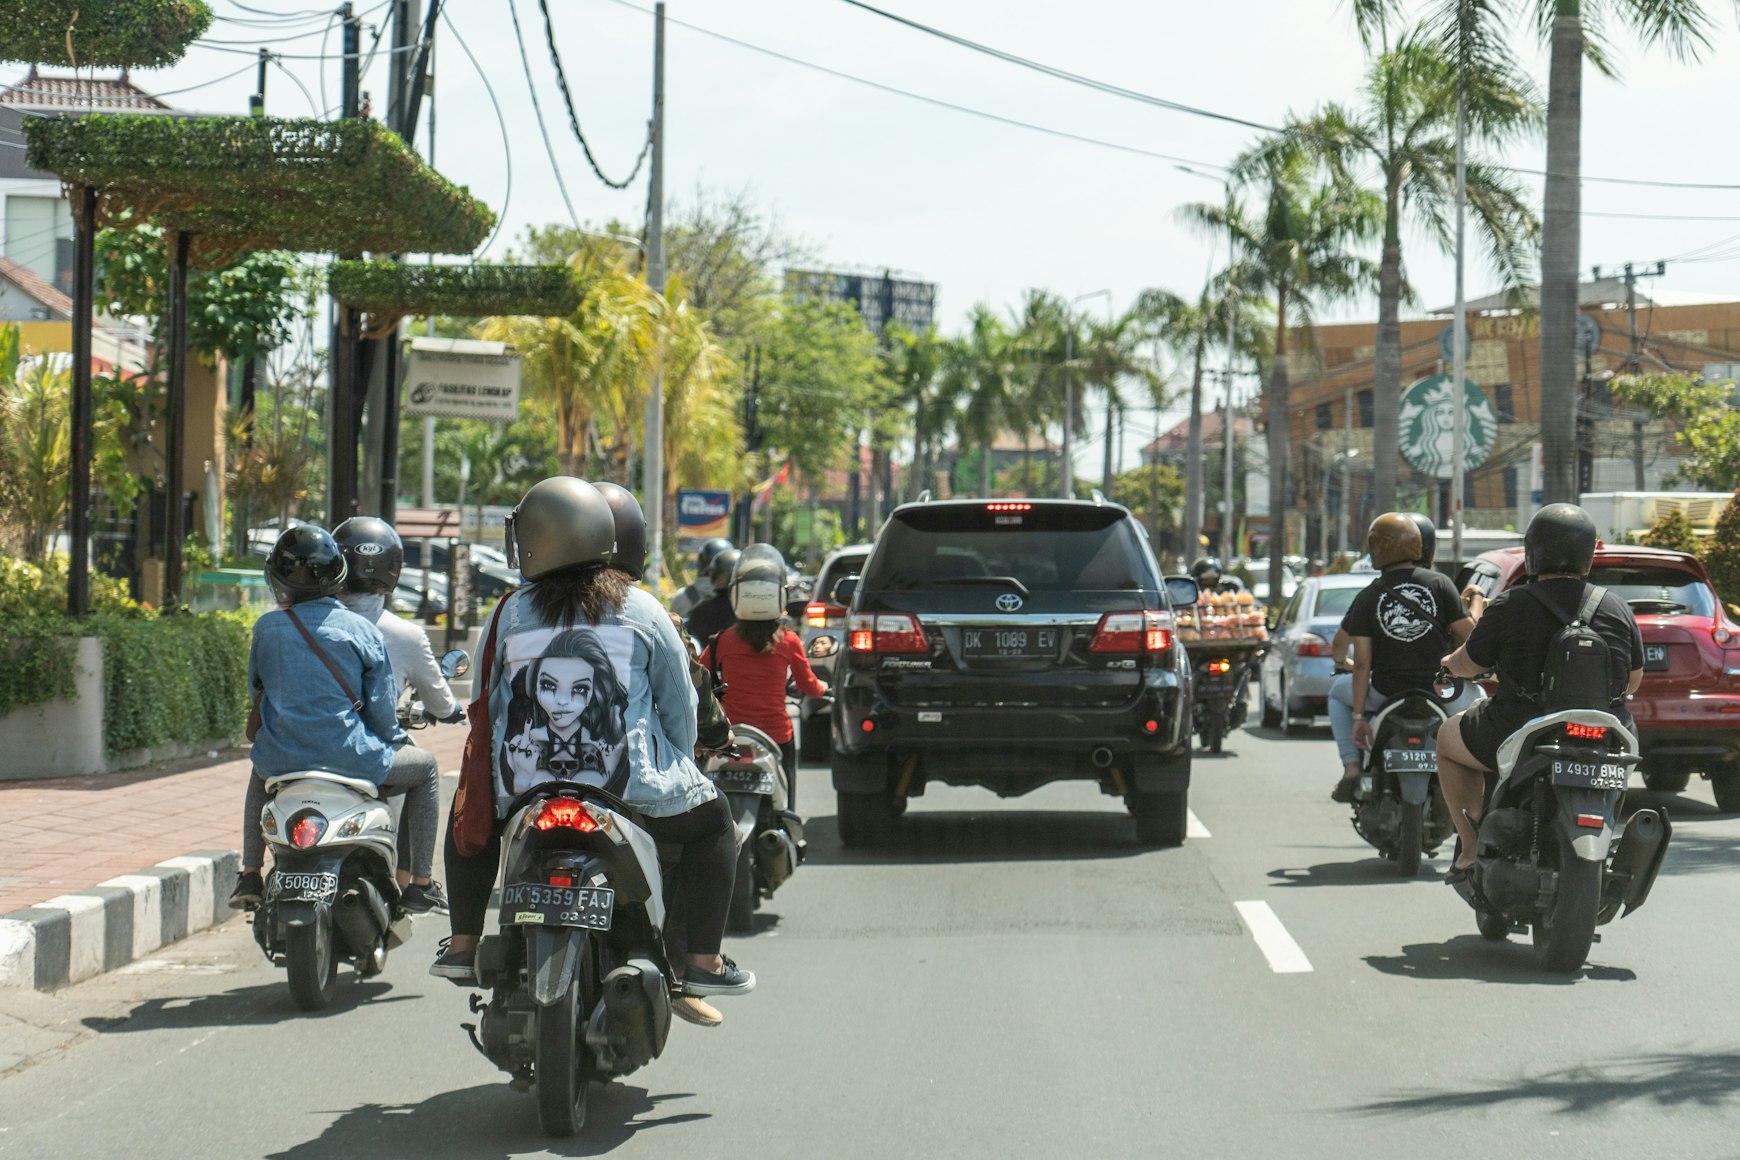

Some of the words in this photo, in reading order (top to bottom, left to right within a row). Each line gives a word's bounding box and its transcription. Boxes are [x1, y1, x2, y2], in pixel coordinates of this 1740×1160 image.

[965, 631, 982, 648] DK
[994, 631, 1028, 648] 1089
[1401, 752, 1427, 761] 5120
[1554, 762, 1562, 774] B
[1567, 763, 1597, 777] 4937
[1600, 765, 1625, 779] BMR
[284, 875, 319, 891] 5080
[504, 886, 526, 904] DK
[530, 887, 574, 906] 5359
[578, 890, 612, 909] FAJ
